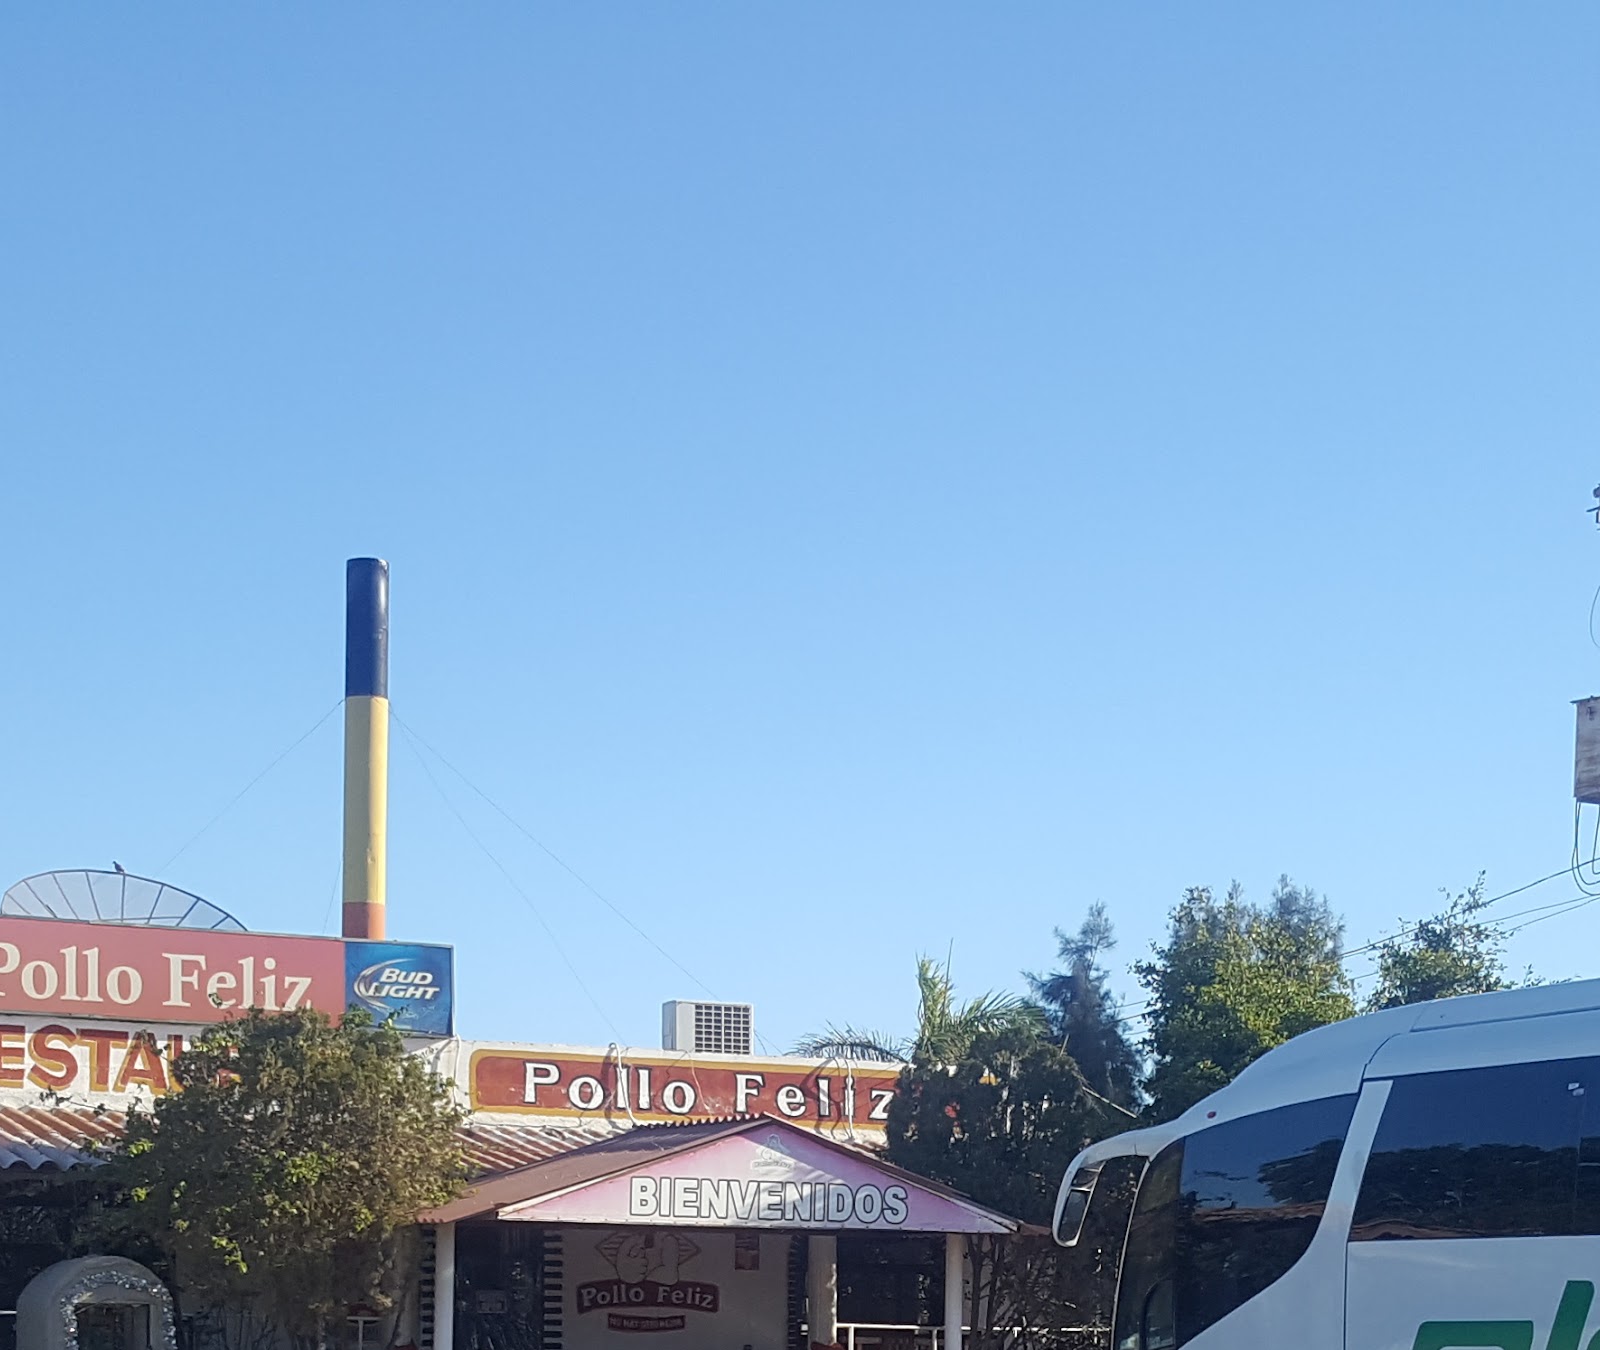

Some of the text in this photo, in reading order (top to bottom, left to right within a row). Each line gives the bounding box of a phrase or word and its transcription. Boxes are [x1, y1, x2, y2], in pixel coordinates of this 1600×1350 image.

[161, 952, 314, 1012] Feliz
[367, 982, 440, 1000] LIGHT
[379, 967, 434, 985] BUD
[523, 1060, 897, 1121] Pollo Feliz
[628, 1175, 909, 1226] BIENVENIDOS
[580, 1283, 714, 1309] Pollo Feliz
